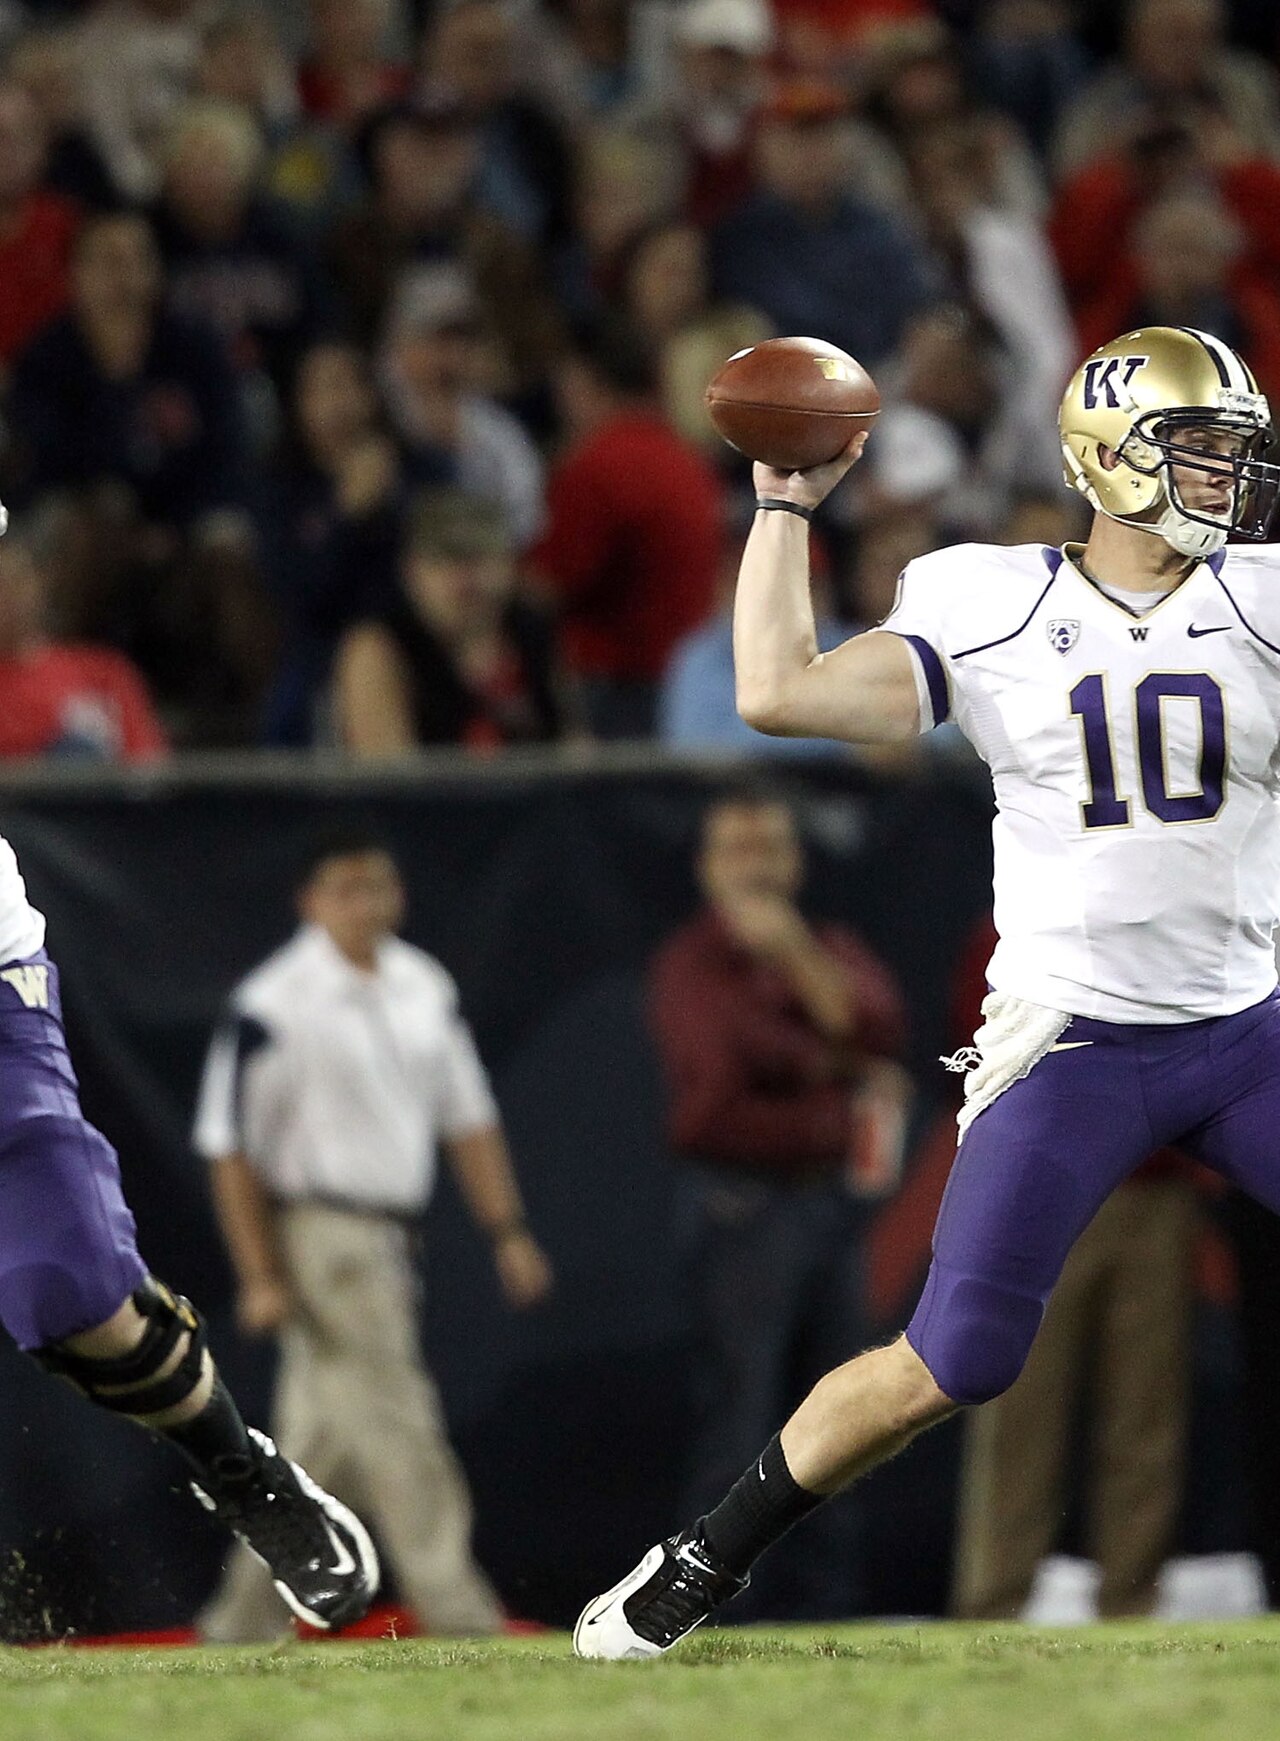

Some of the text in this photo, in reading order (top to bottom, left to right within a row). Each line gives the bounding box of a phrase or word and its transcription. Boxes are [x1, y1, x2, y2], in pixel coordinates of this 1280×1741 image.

[1083, 356, 1148, 410] W
[1128, 627, 1149, 642] W
[1067, 670, 1231, 832] 10
[0, 965, 49, 1008] W
